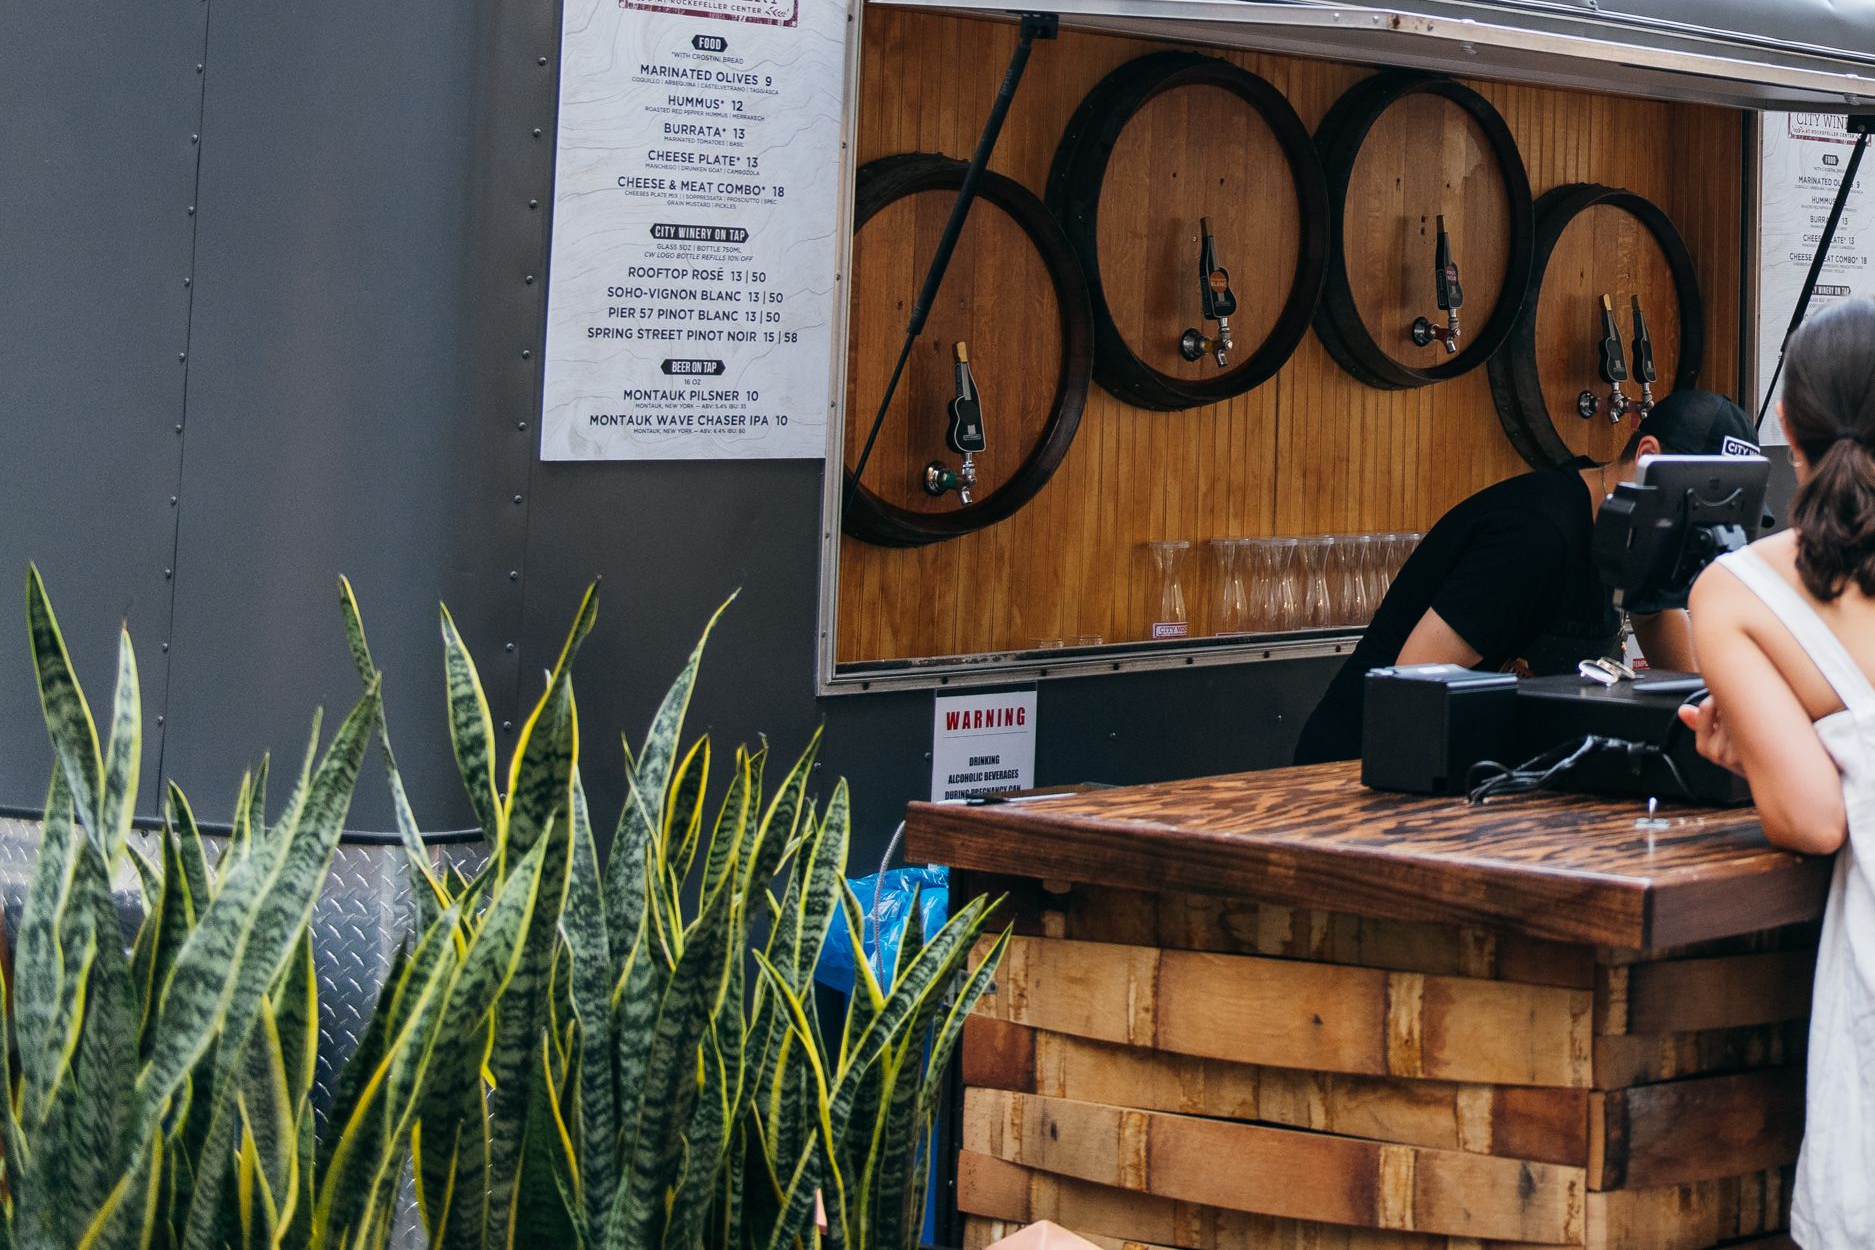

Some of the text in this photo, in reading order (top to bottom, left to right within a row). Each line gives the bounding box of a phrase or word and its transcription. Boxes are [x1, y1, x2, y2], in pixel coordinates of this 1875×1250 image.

[731, 5, 762, 14] CENTER
[699, 37, 721, 50] FOOD
[723, 56, 743, 64] BREAD
[640, 64, 772, 86] MARINATED OLIVES 9
[732, 100, 743, 111] 12
[1797, 113, 1848, 129] CITY WIN
[734, 128, 745, 139] 13
[664, 136, 695, 144] MARINATED
[697, 138, 725, 146] TOMATOES
[648, 150, 695, 163] CHEESE
[746, 157, 758, 168] 13
[1825, 156, 1836, 164] FOOD
[645, 163, 676, 171] MANCHEGO
[617, 176, 665, 190] CHEESE
[669, 179, 676, 190] &
[680, 181, 714, 193] MEAT
[773, 186, 785, 197] 18
[1799, 176, 1832, 186] MARINATED
[715, 202, 736, 210] PICKLES
[655, 225, 745, 241] CITY WINERY ON TAP
[1803, 234, 1821, 242] CHEES
[1790, 253, 1812, 261] CHEESE
[628, 266, 766, 282] ROOFTOP ROSÉ 13 50
[607, 286, 783, 303] SOHO-VIGNON BLANC 13 50
[608, 307, 780, 323] PIER 57 PINOT BLANC 13 50
[587, 327, 798, 343] SPRING STREET PINOT NOIR 15 58
[672, 362, 717, 373] BEER ON TAP
[623, 390, 758, 401] MONTAUK PILSNER 10
[589, 415, 788, 426] MONTAUK WAVE CHASER IPA 10
[1728, 442, 1748, 455] CITY
[946, 707, 1026, 730] WARNING
[969, 755, 1000, 766] DRINKING
[948, 769, 1019, 785] ALCOHOLIC BEVERAGES
